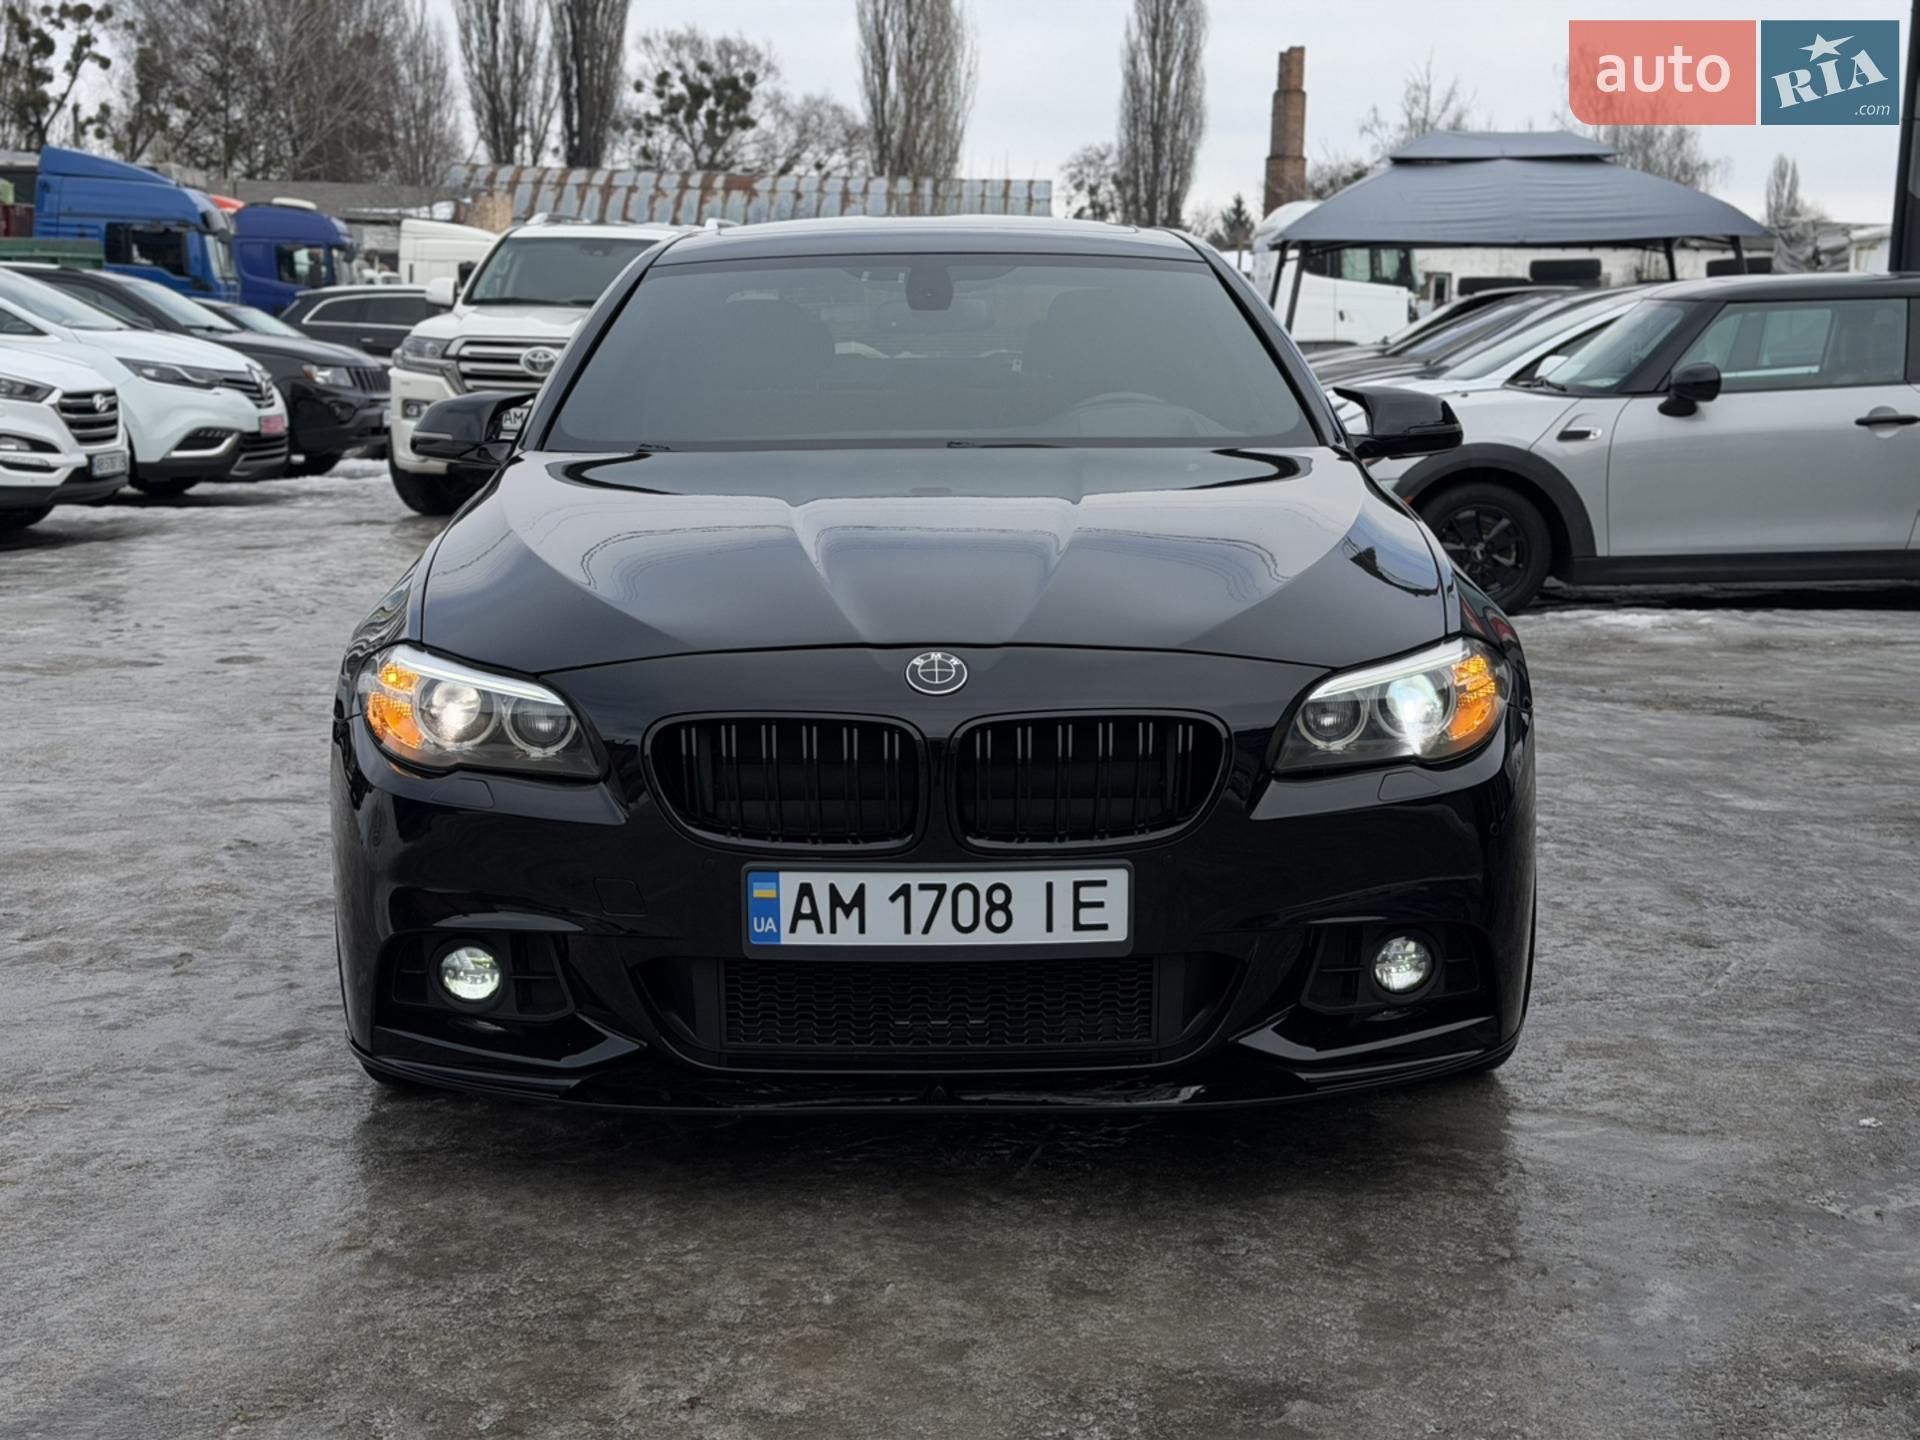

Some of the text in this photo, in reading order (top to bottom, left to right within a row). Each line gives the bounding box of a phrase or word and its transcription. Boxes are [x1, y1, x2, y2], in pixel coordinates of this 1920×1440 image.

[753, 917, 778, 933] UA
[788, 879, 1109, 935] AM 1708 IE
